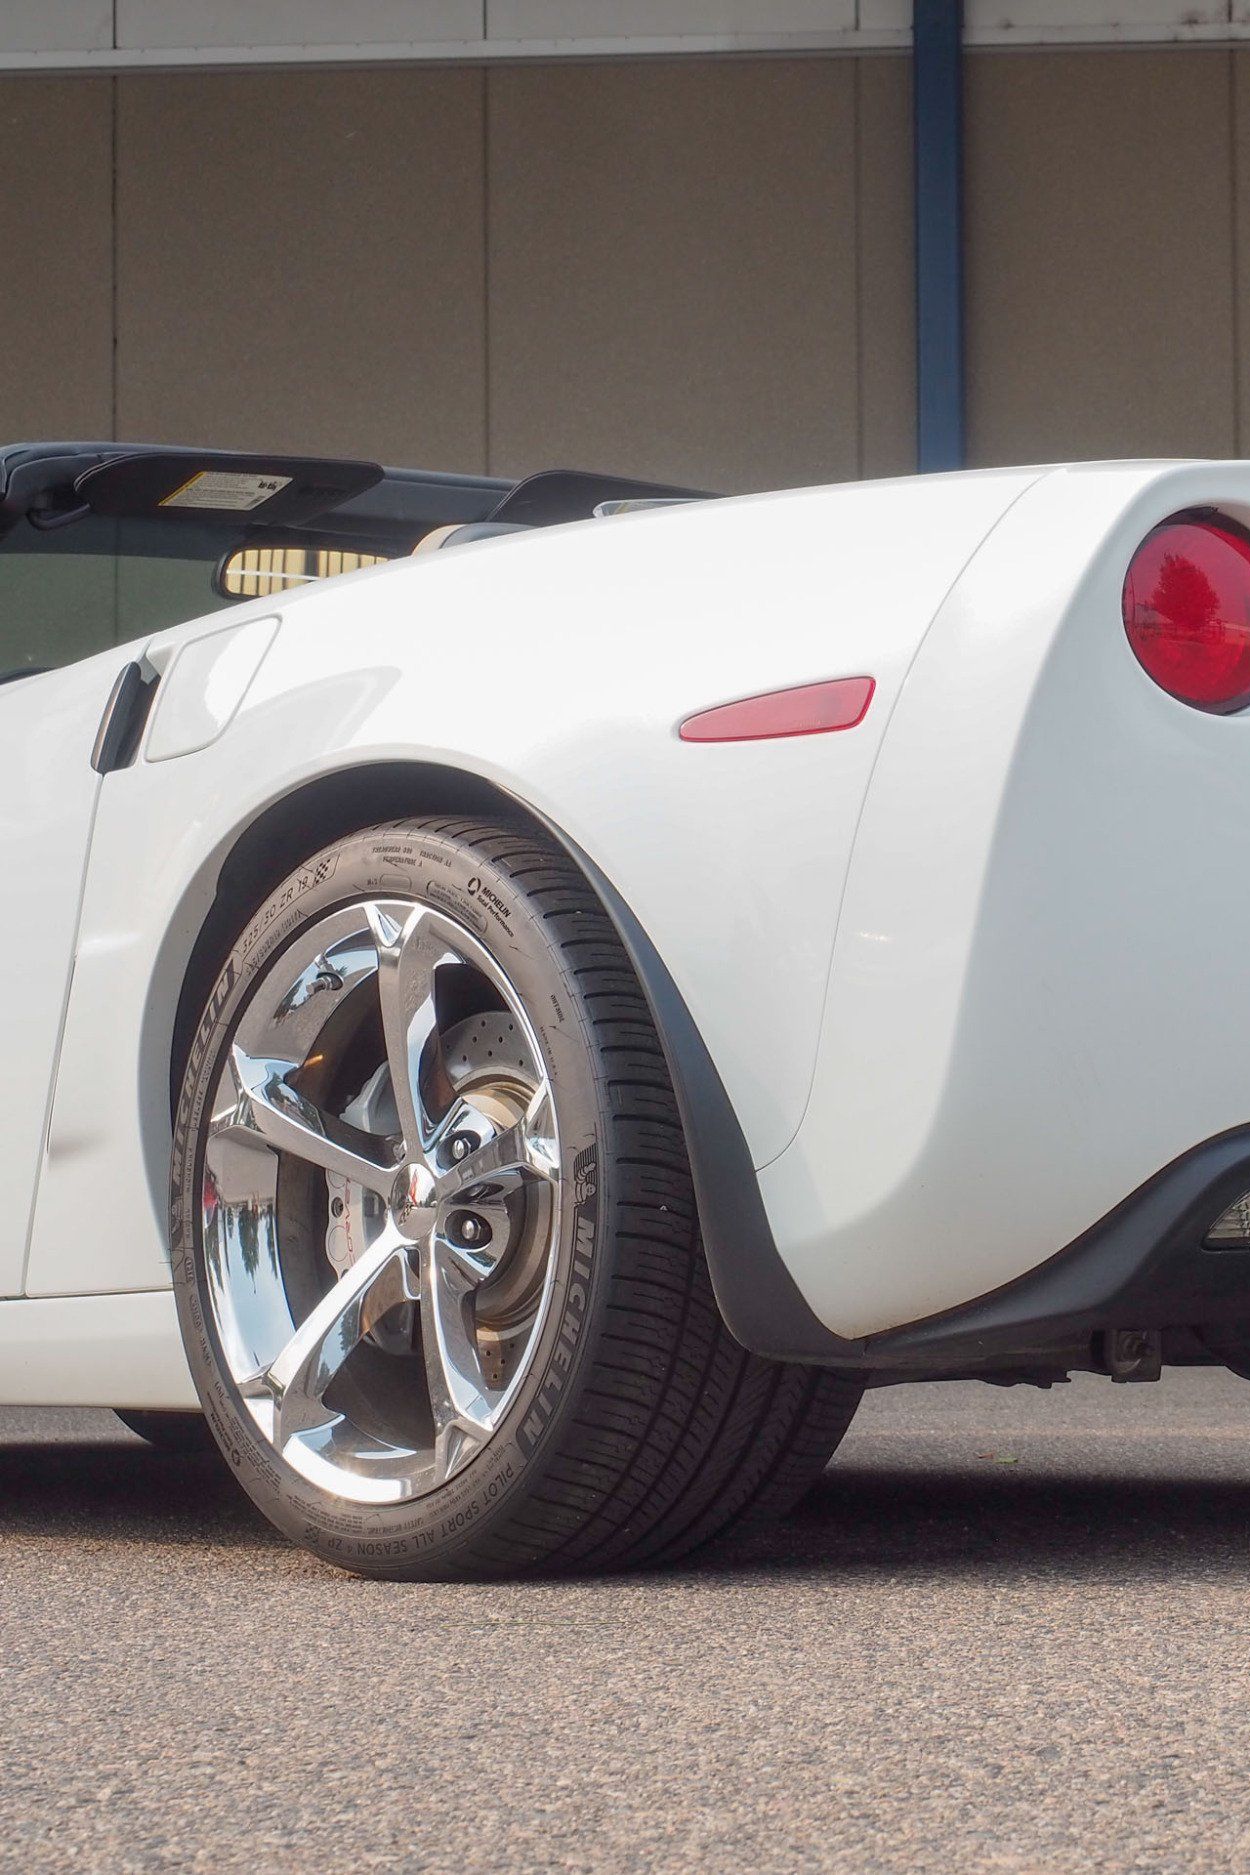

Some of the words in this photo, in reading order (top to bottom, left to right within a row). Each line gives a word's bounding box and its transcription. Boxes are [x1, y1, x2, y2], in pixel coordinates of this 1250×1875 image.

[280, 887, 294, 908] ZR
[481, 887, 511, 918] MICHELIN
[477, 895, 488, 908] Total
[487, 905, 514, 937] Performance
[173, 972, 235, 1186] MICHELIN
[523, 1216, 595, 1446] MICHELIN
[482, 1462, 515, 1505] PILOT
[441, 1504, 480, 1533] SPORT
[328, 1537, 344, 1548] ZP
[357, 1538, 408, 1556] SEASON
[413, 1533, 434, 1548] ALL
